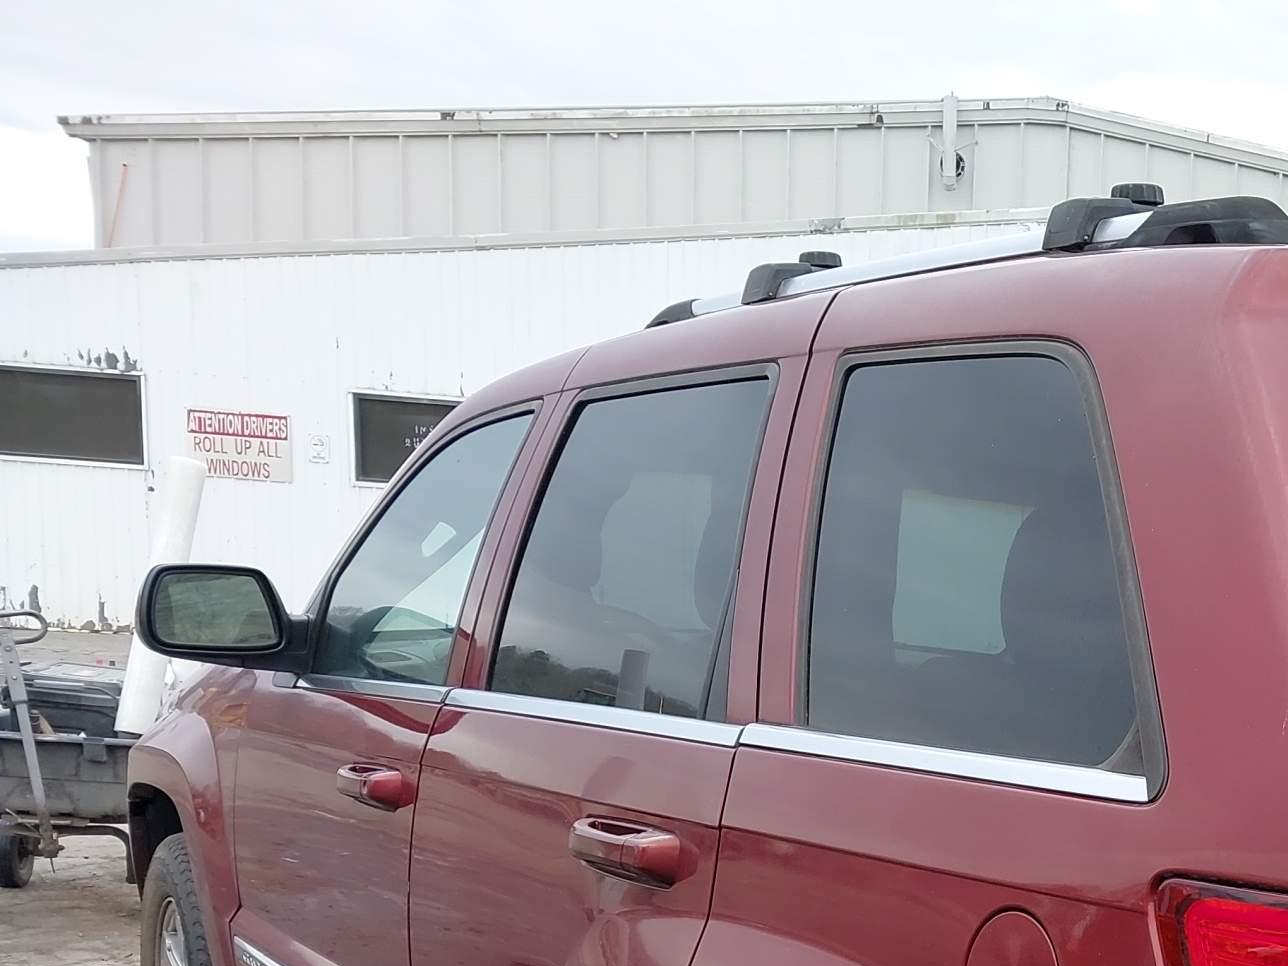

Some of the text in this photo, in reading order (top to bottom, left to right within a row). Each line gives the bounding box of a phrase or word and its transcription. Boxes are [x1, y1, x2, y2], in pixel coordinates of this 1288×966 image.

[188, 411, 287, 438] ATTENTION DRIVERS
[193, 435, 283, 459] ROLL UP ALL
[206, 457, 271, 479] WINDOWS
